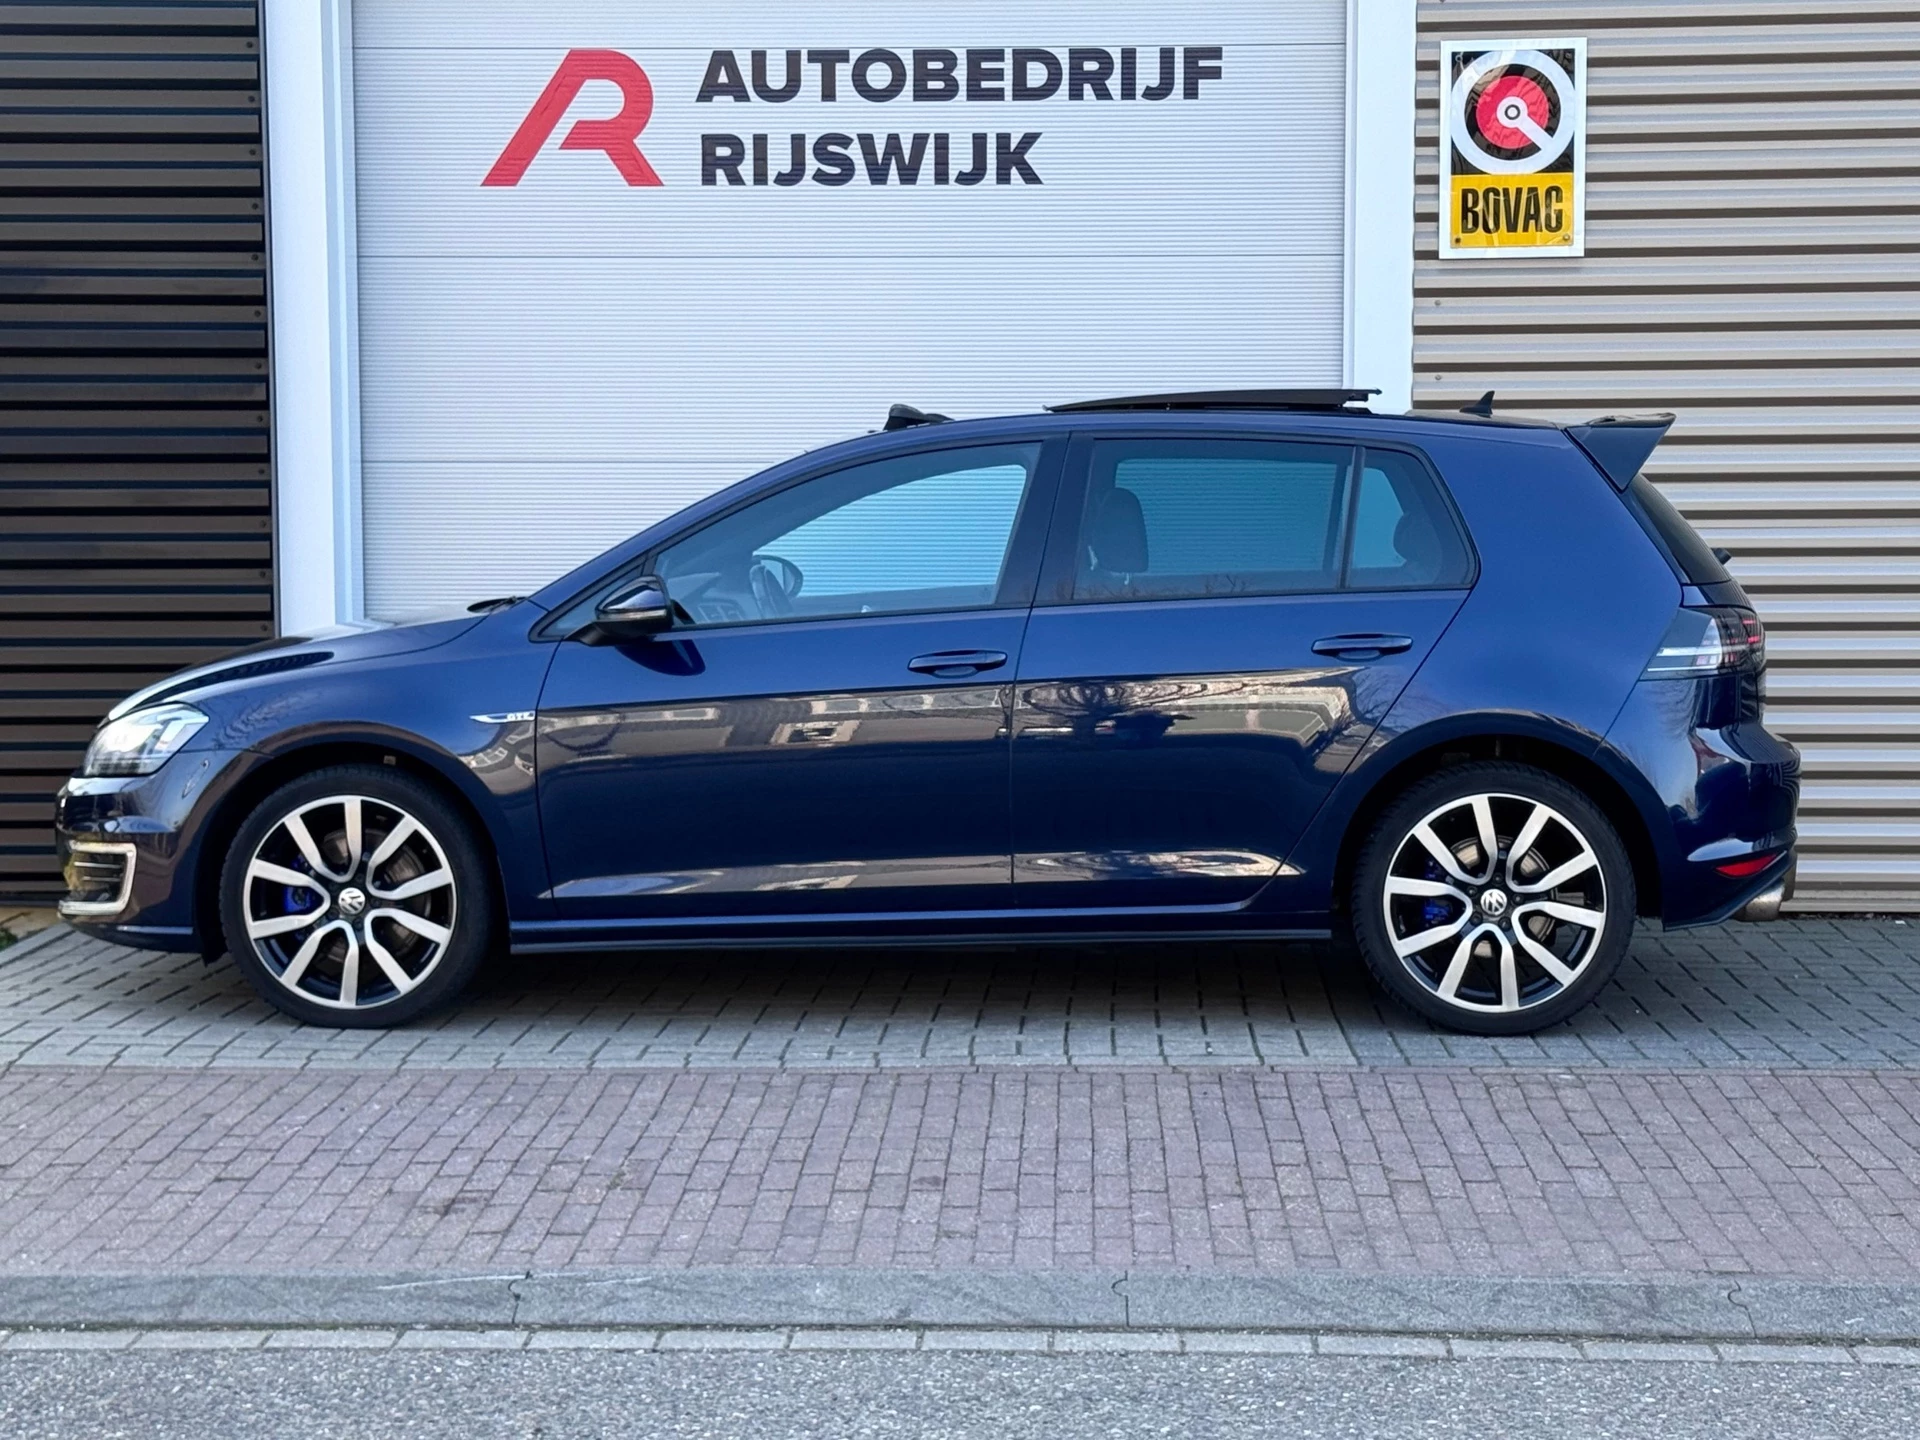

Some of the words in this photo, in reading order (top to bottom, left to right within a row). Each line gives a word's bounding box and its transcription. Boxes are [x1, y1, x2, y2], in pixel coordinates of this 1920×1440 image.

[696, 47, 1223, 103] AUTOBEDRIJF
[701, 132, 1043, 186] RIJSWIJK
[1461, 185, 1563, 234] BOVAG
